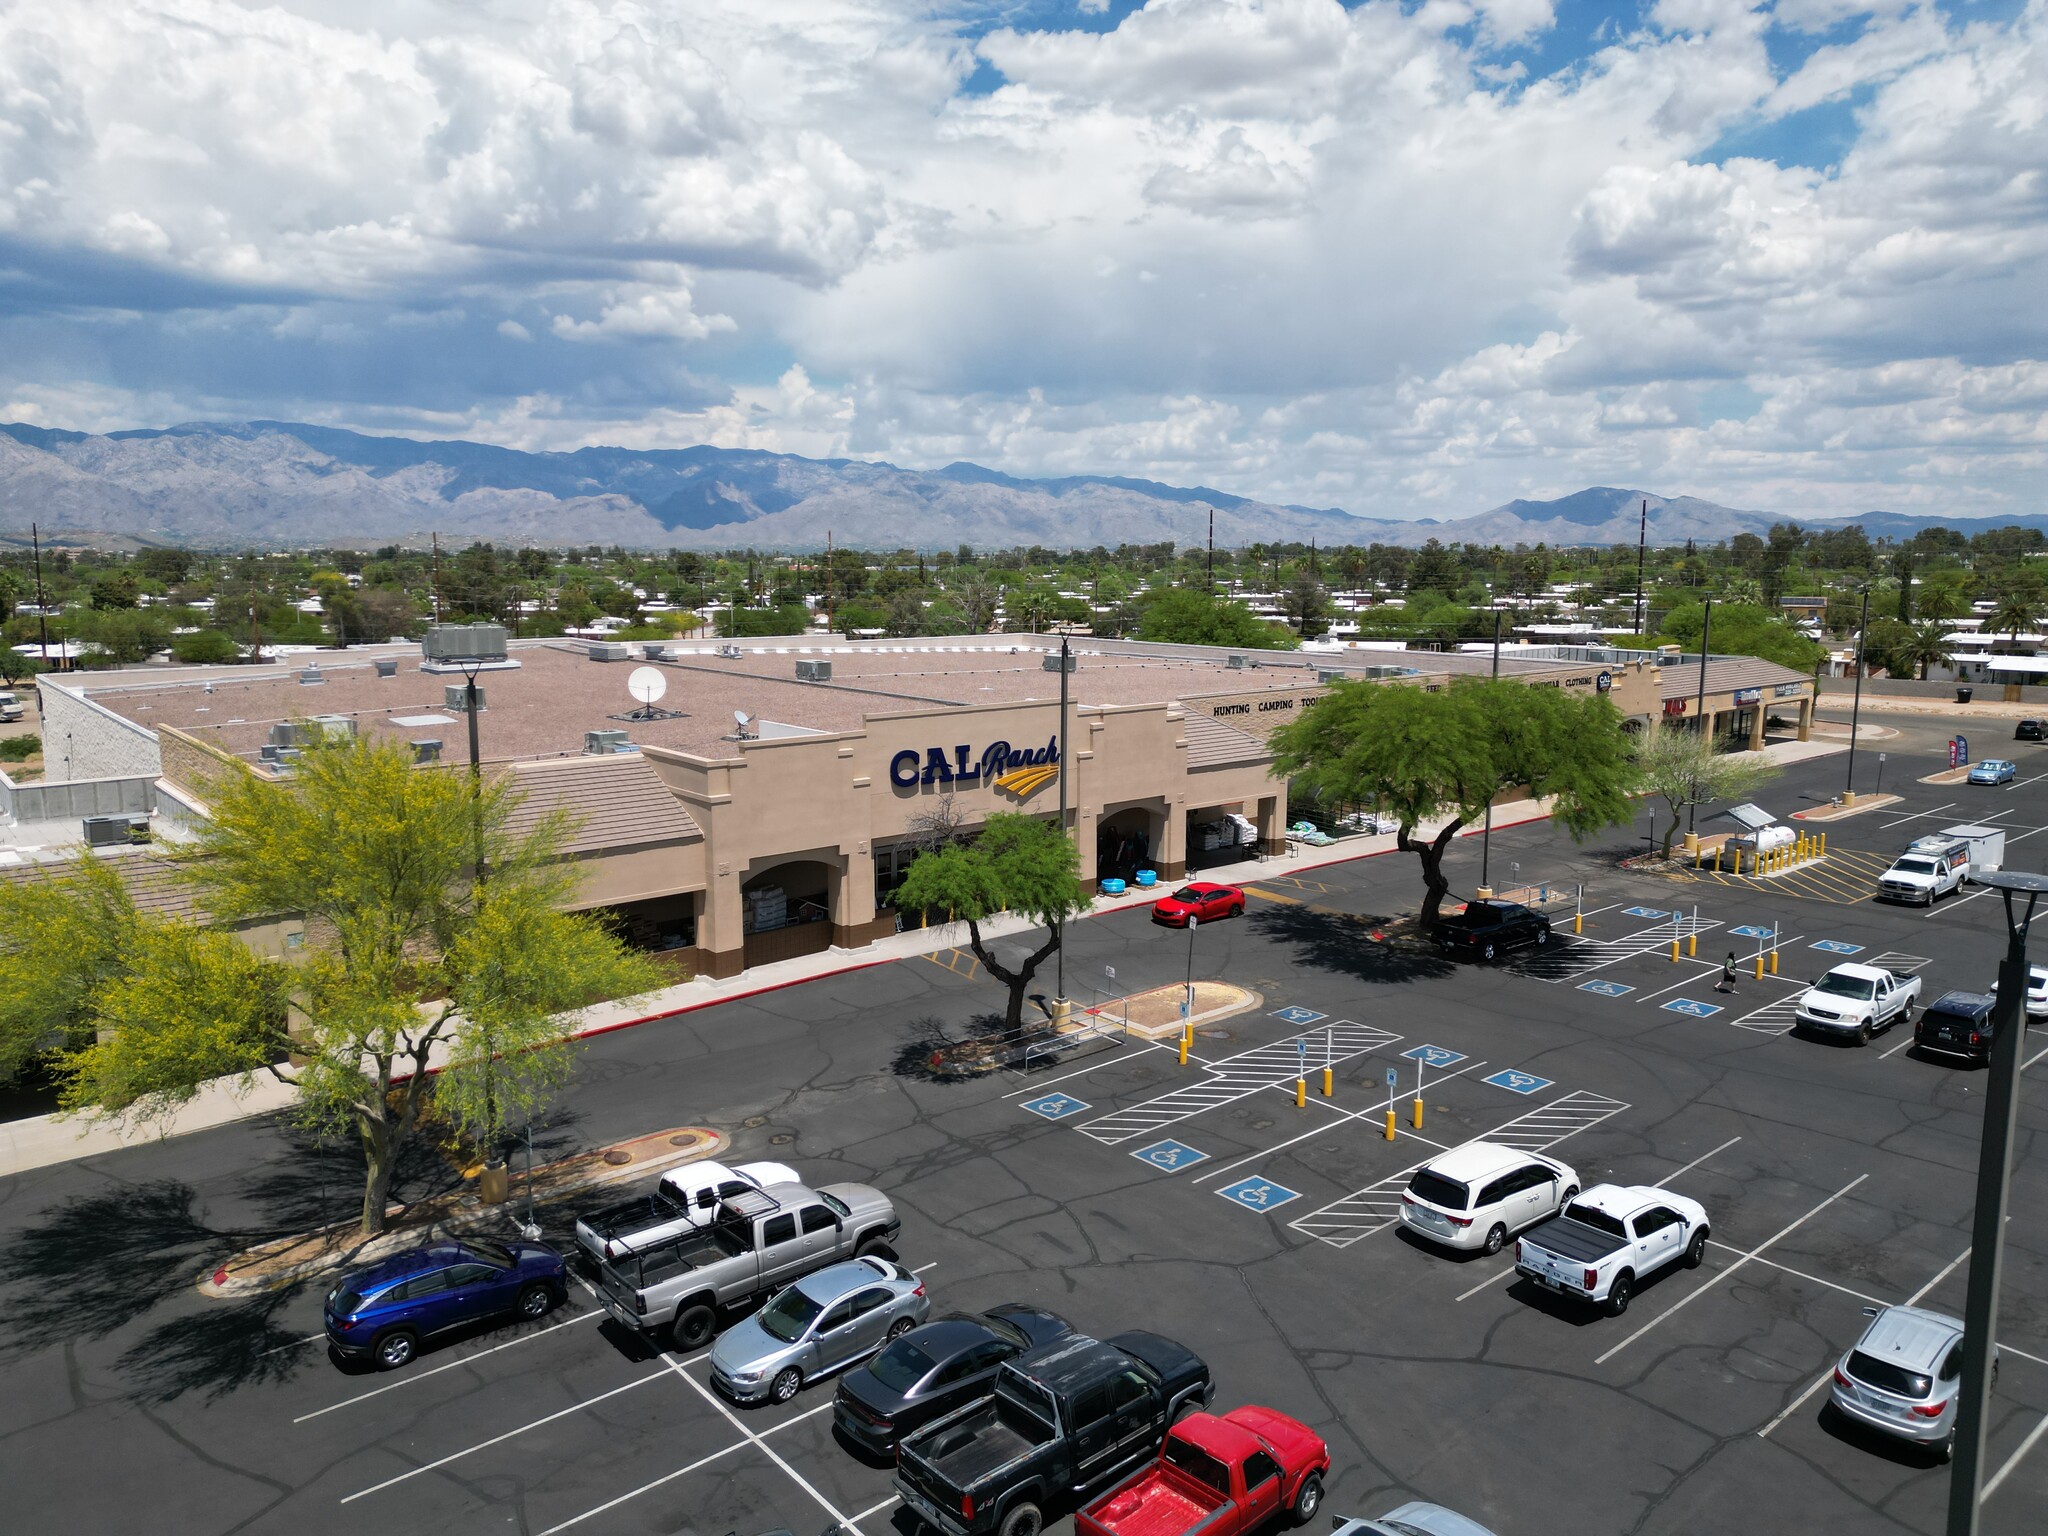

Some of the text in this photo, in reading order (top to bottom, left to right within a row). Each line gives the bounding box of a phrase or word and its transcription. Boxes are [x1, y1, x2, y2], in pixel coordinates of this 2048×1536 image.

[1565, 677, 1592, 687] CLOTHING
[1599, 675, 1611, 684] CAL
[1213, 704, 1250, 716] HUNTING
[1258, 699, 1293, 712] CAMPING
[890, 735, 1061, 787] CAL Ranch
[1522, 1258, 1583, 1287] RANGER
